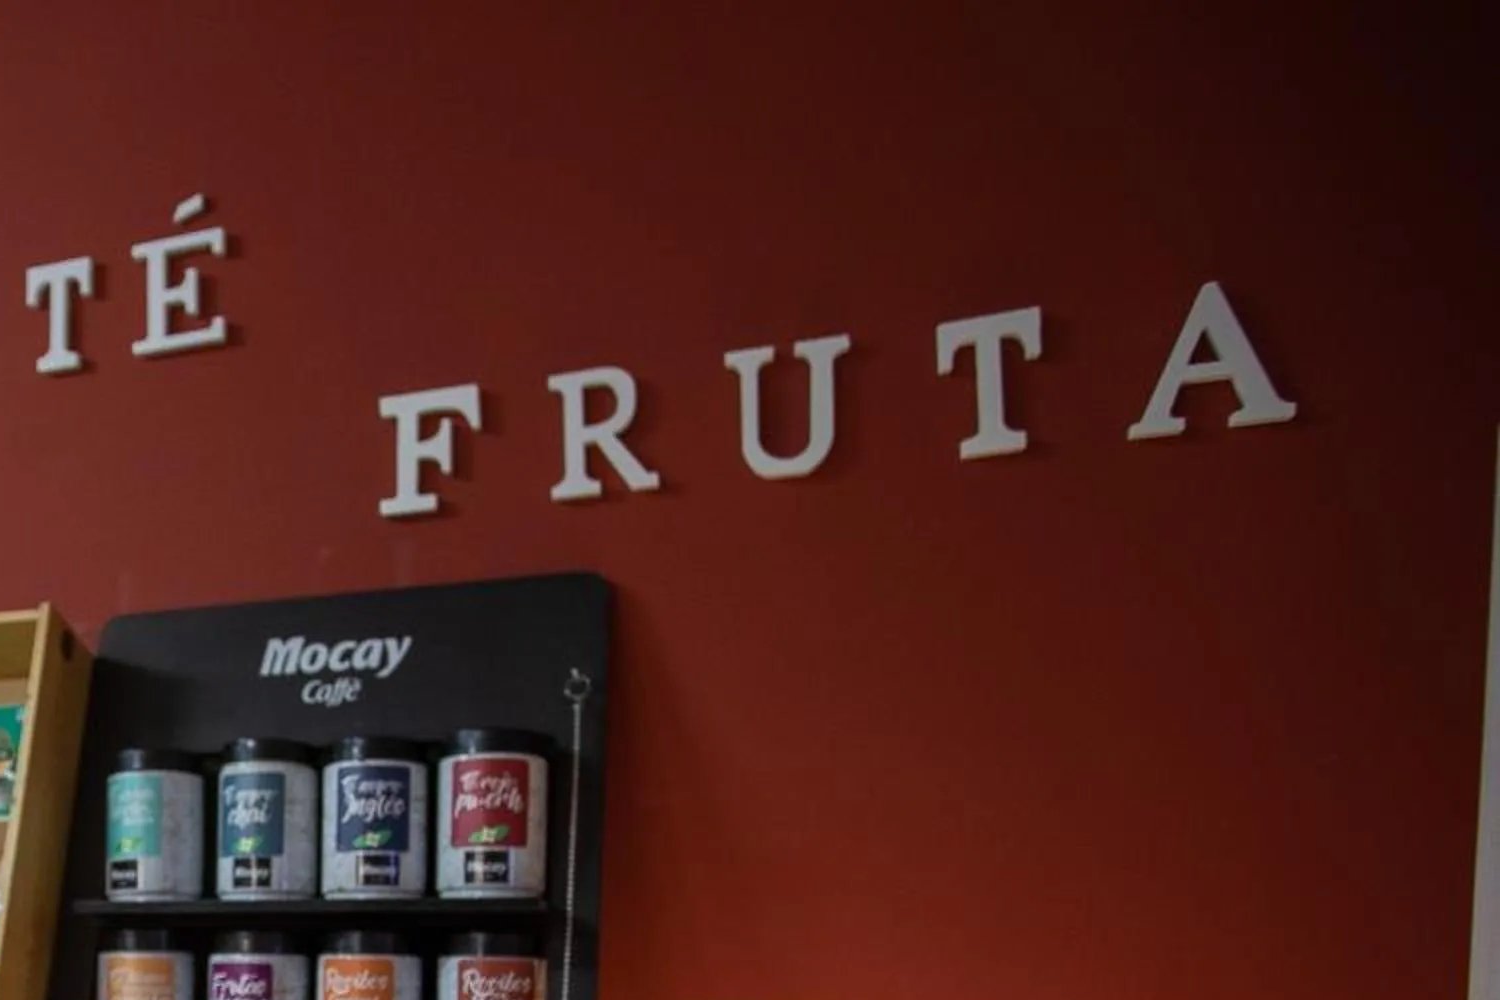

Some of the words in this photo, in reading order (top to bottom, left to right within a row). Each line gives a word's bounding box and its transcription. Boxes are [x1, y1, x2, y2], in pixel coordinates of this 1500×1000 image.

[25, 193, 226, 374] TÉ
[379, 280, 1298, 517] FRUTA
[260, 635, 413, 678] Mocay
